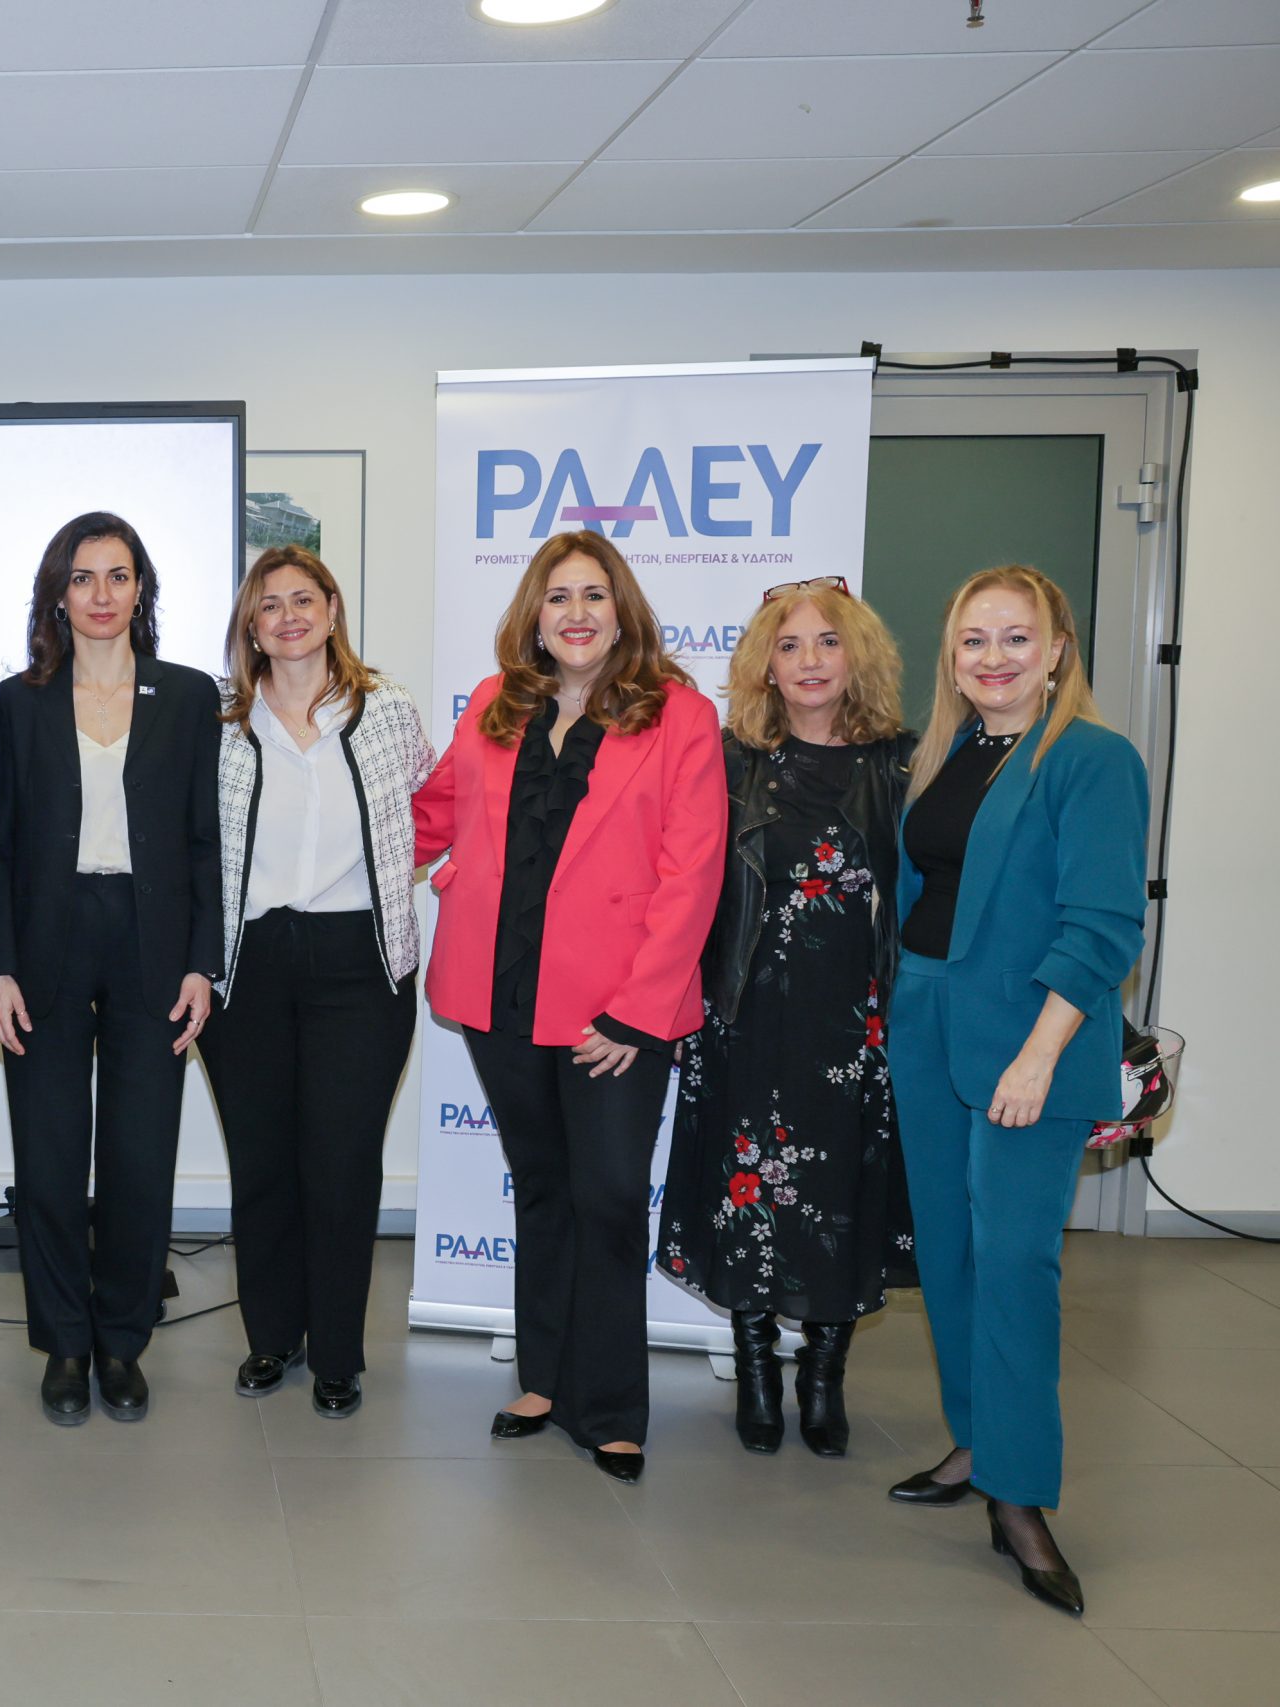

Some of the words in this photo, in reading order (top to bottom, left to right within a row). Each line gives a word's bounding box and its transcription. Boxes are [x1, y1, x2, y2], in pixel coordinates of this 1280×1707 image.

[625, 554, 662, 566] ΗΤΩΝ,
[664, 553, 729, 564] ΕΝΕΡΓΕΙΑΣ
[730, 553, 740, 564] &
[741, 553, 793, 564] ΥΔΑΤΩΝ
[440, 1102, 499, 1130] ΡΑΑ
